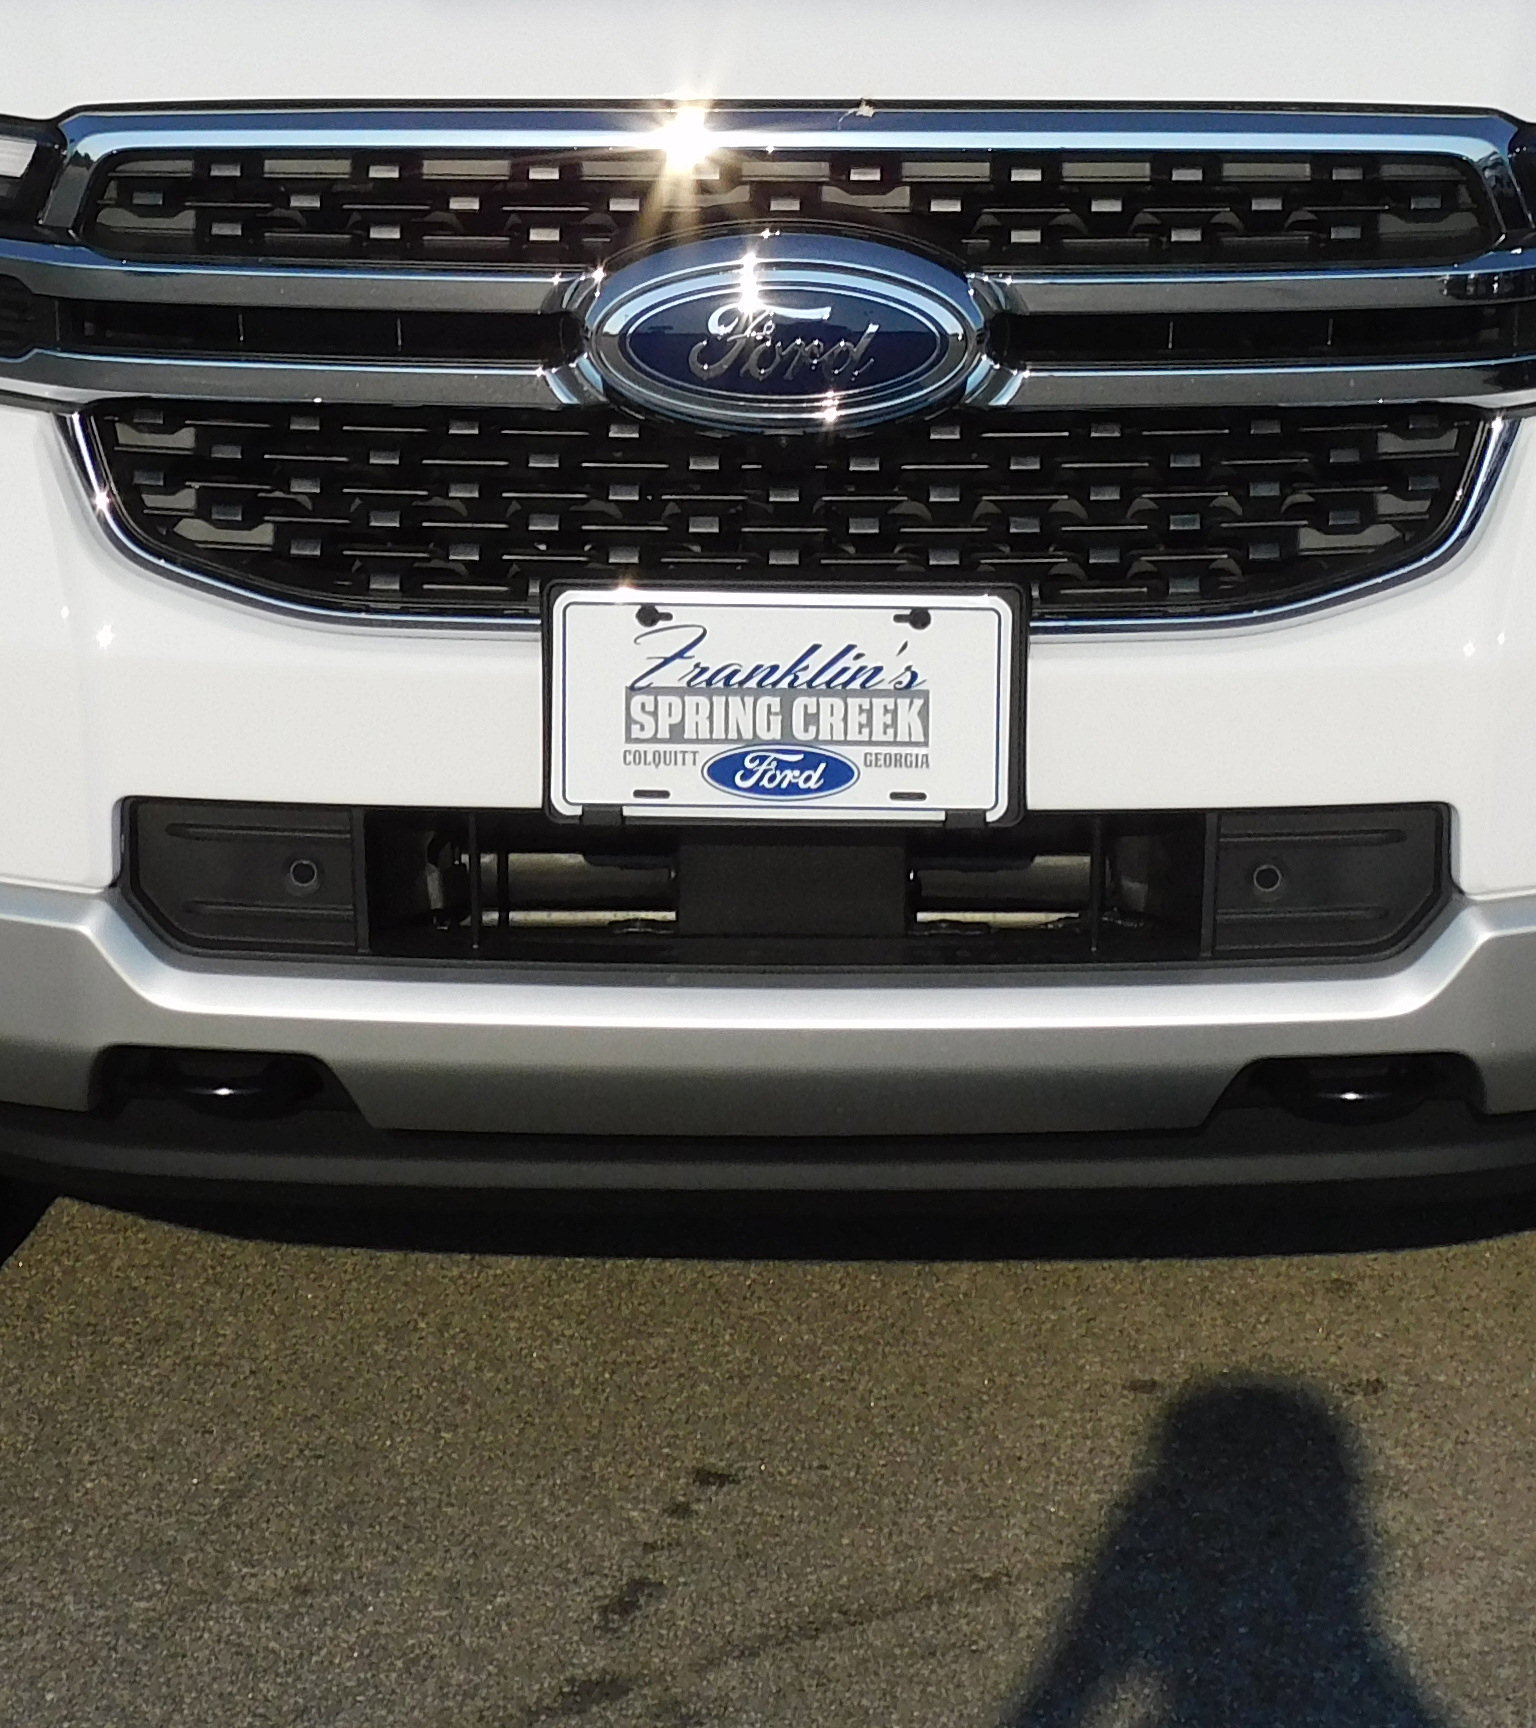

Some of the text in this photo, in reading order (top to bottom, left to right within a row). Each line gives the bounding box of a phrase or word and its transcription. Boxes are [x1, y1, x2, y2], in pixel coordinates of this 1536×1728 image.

[688, 303, 880, 381] Ford
[626, 624, 928, 691] Franklin's
[629, 695, 929, 743] SPRING CREEK
[622, 749, 701, 769] COLQUITT
[733, 752, 825, 791] Ford
[863, 752, 931, 770] GEORGIA
